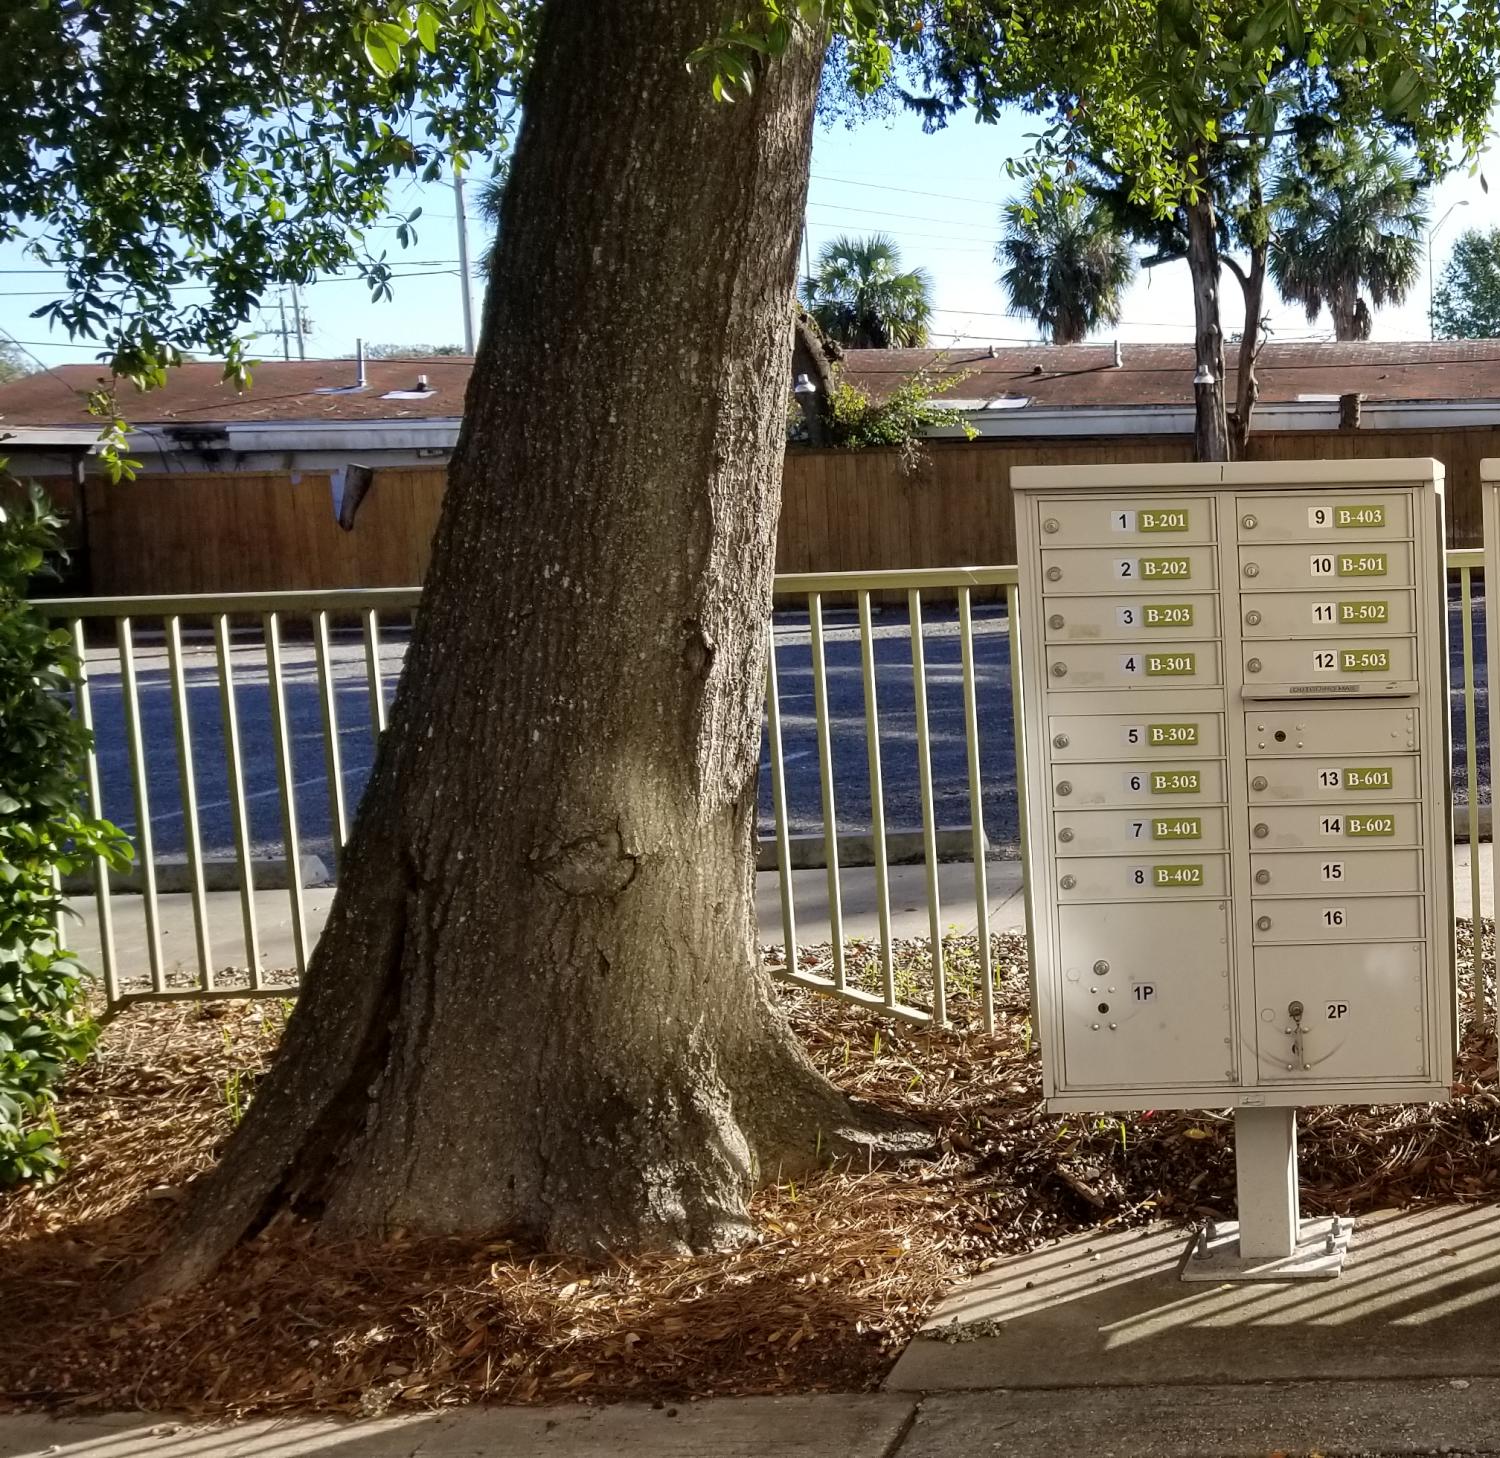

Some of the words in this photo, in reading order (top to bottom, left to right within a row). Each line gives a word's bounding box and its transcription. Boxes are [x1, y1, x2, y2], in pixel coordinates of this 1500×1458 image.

[1118, 513, 1127, 529] 1
[1142, 513, 1185, 528] B-201
[1315, 509, 1326, 525] 9
[1339, 509, 1382, 524] B-403
[1120, 561, 1132, 577] 2
[1144, 561, 1188, 575] B-202
[1312, 558, 1332, 573] 10
[1342, 557, 1384, 572] B-501
[1123, 609, 1134, 625] 3
[1147, 608, 1190, 622] B-203
[1314, 605, 1332, 621] 11
[1342, 605, 1385, 619] B-502
[1125, 657, 1136, 672] 4
[1149, 657, 1192, 671] B-301
[1315, 653, 1335, 669] 12
[1344, 653, 1387, 667] B-503
[1128, 728, 1139, 744] 5
[1152, 727, 1195, 741] B-302
[1130, 776, 1141, 791] 6
[1155, 775, 1197, 789] B-303
[1320, 771, 1339, 787] 13
[1348, 771, 1390, 786] B-601
[1132, 823, 1143, 838] 7
[1156, 822, 1198, 836] B-401
[1321, 818, 1341, 833] 14
[1350, 818, 1392, 833] B-602
[1134, 869, 1145, 885] 8
[1158, 869, 1200, 883] B-402
[1322, 864, 1342, 879] 15
[1324, 910, 1343, 926] 16
[1134, 985, 1154, 1001] 1P
[1327, 1004, 1348, 1019] 2P
